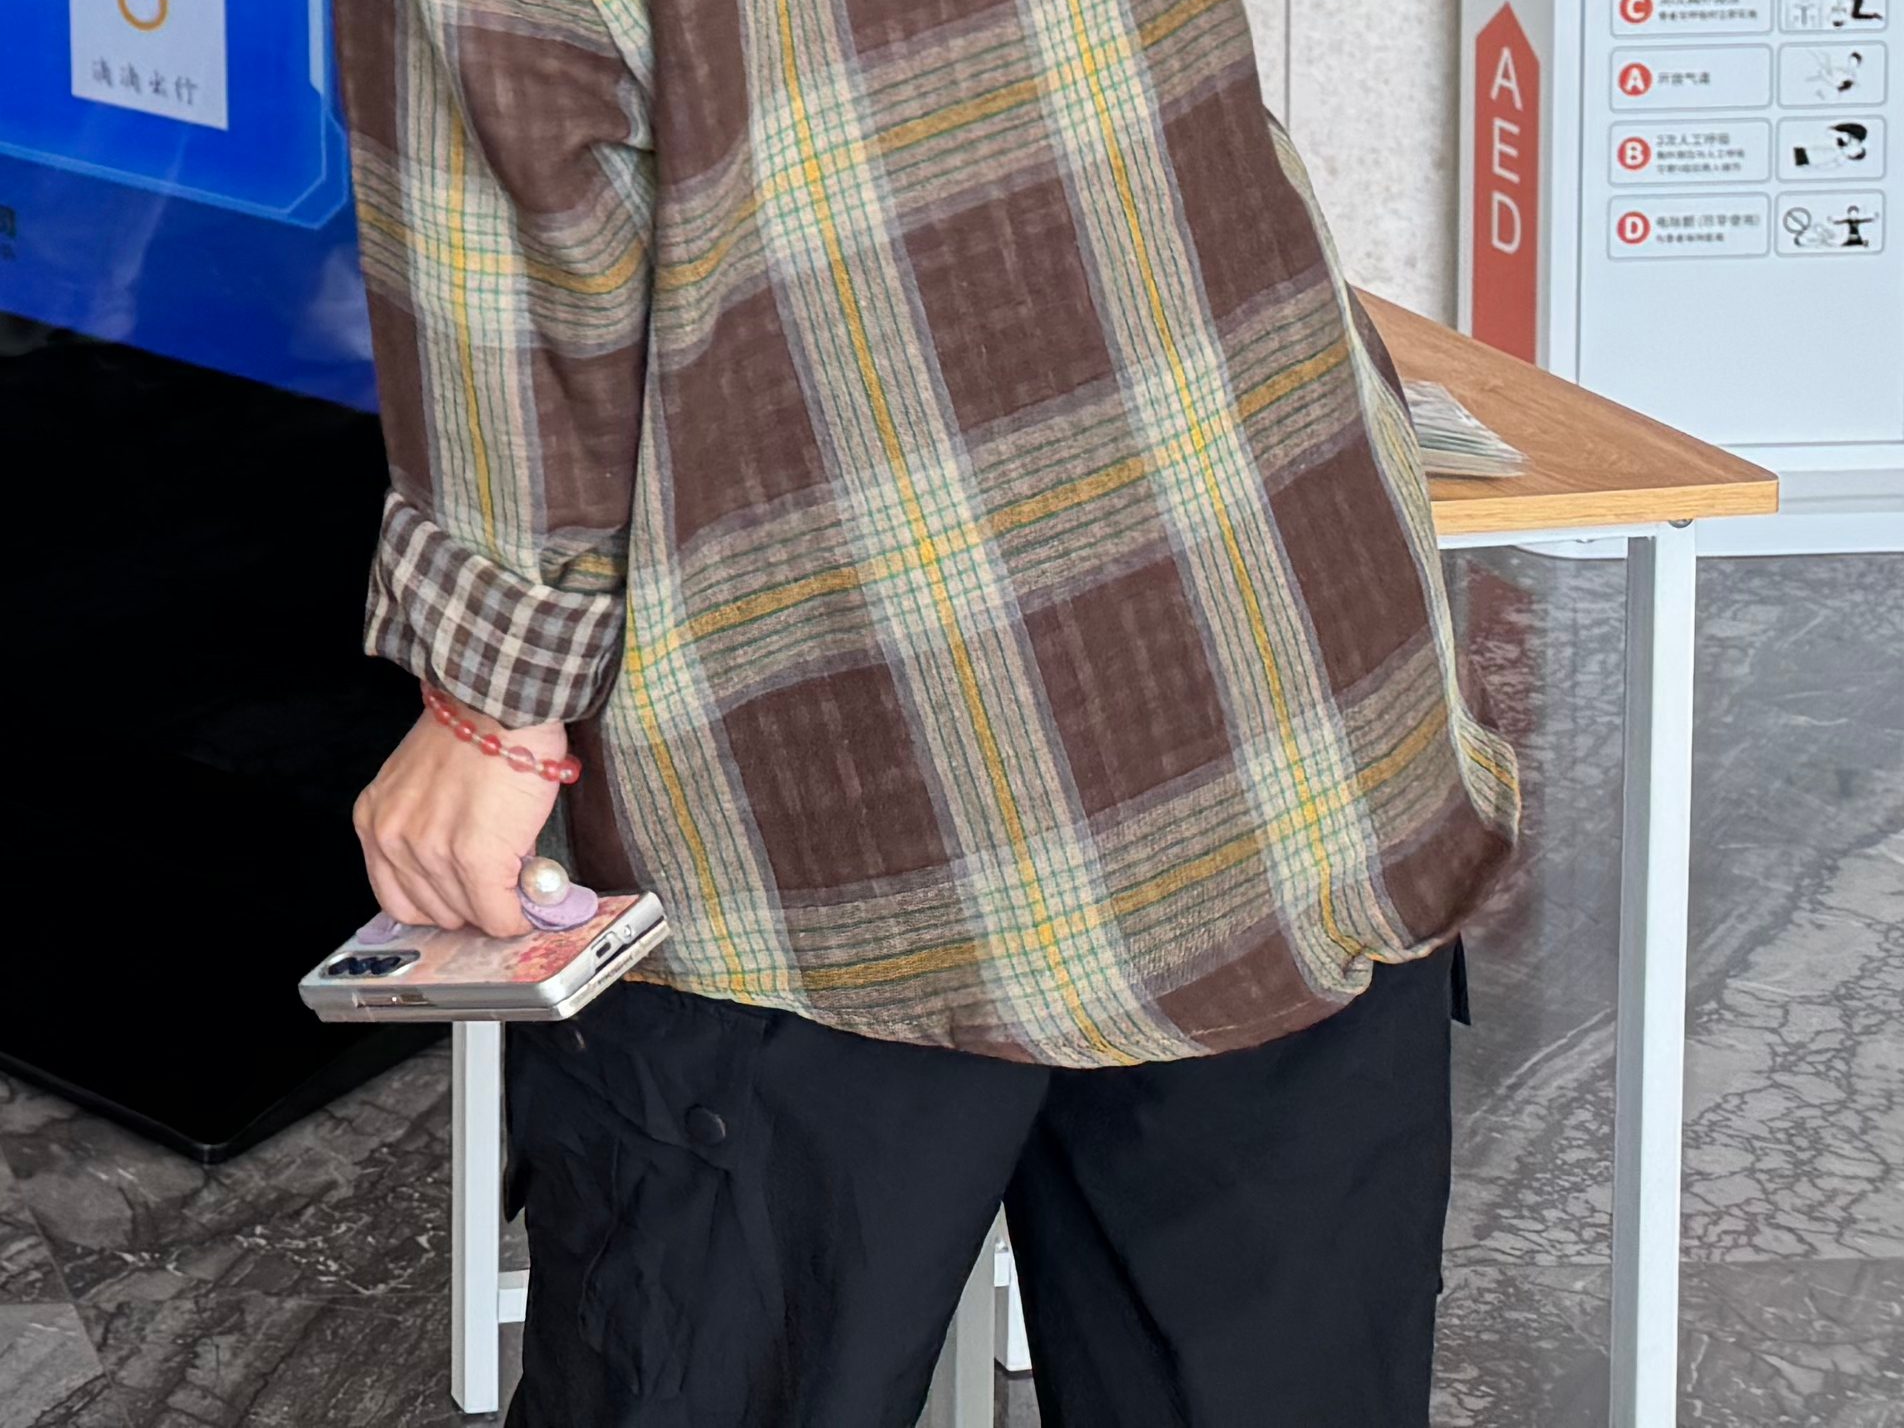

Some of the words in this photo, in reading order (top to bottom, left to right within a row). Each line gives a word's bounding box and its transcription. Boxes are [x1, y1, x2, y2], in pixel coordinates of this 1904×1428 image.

[1624, 67, 1645, 93] A
[1489, 45, 1524, 257] AED
[1625, 141, 1644, 165] B
[1624, 216, 1643, 240] D
